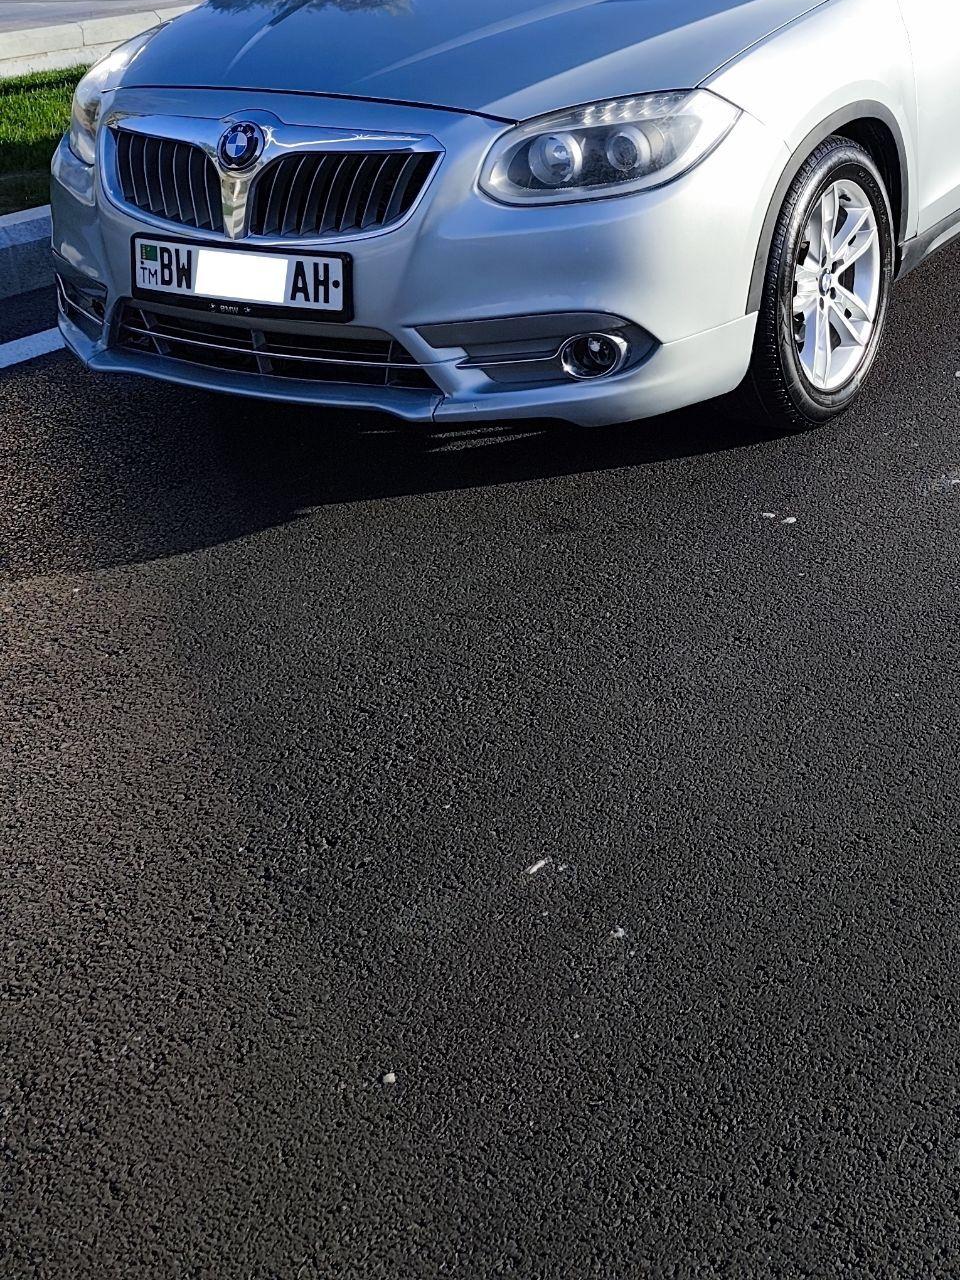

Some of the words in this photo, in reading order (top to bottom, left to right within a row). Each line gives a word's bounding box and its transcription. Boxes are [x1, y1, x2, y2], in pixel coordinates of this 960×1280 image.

[140, 266, 159, 286] TM
[159, 246, 192, 290] BW
[290, 260, 330, 304] AH
